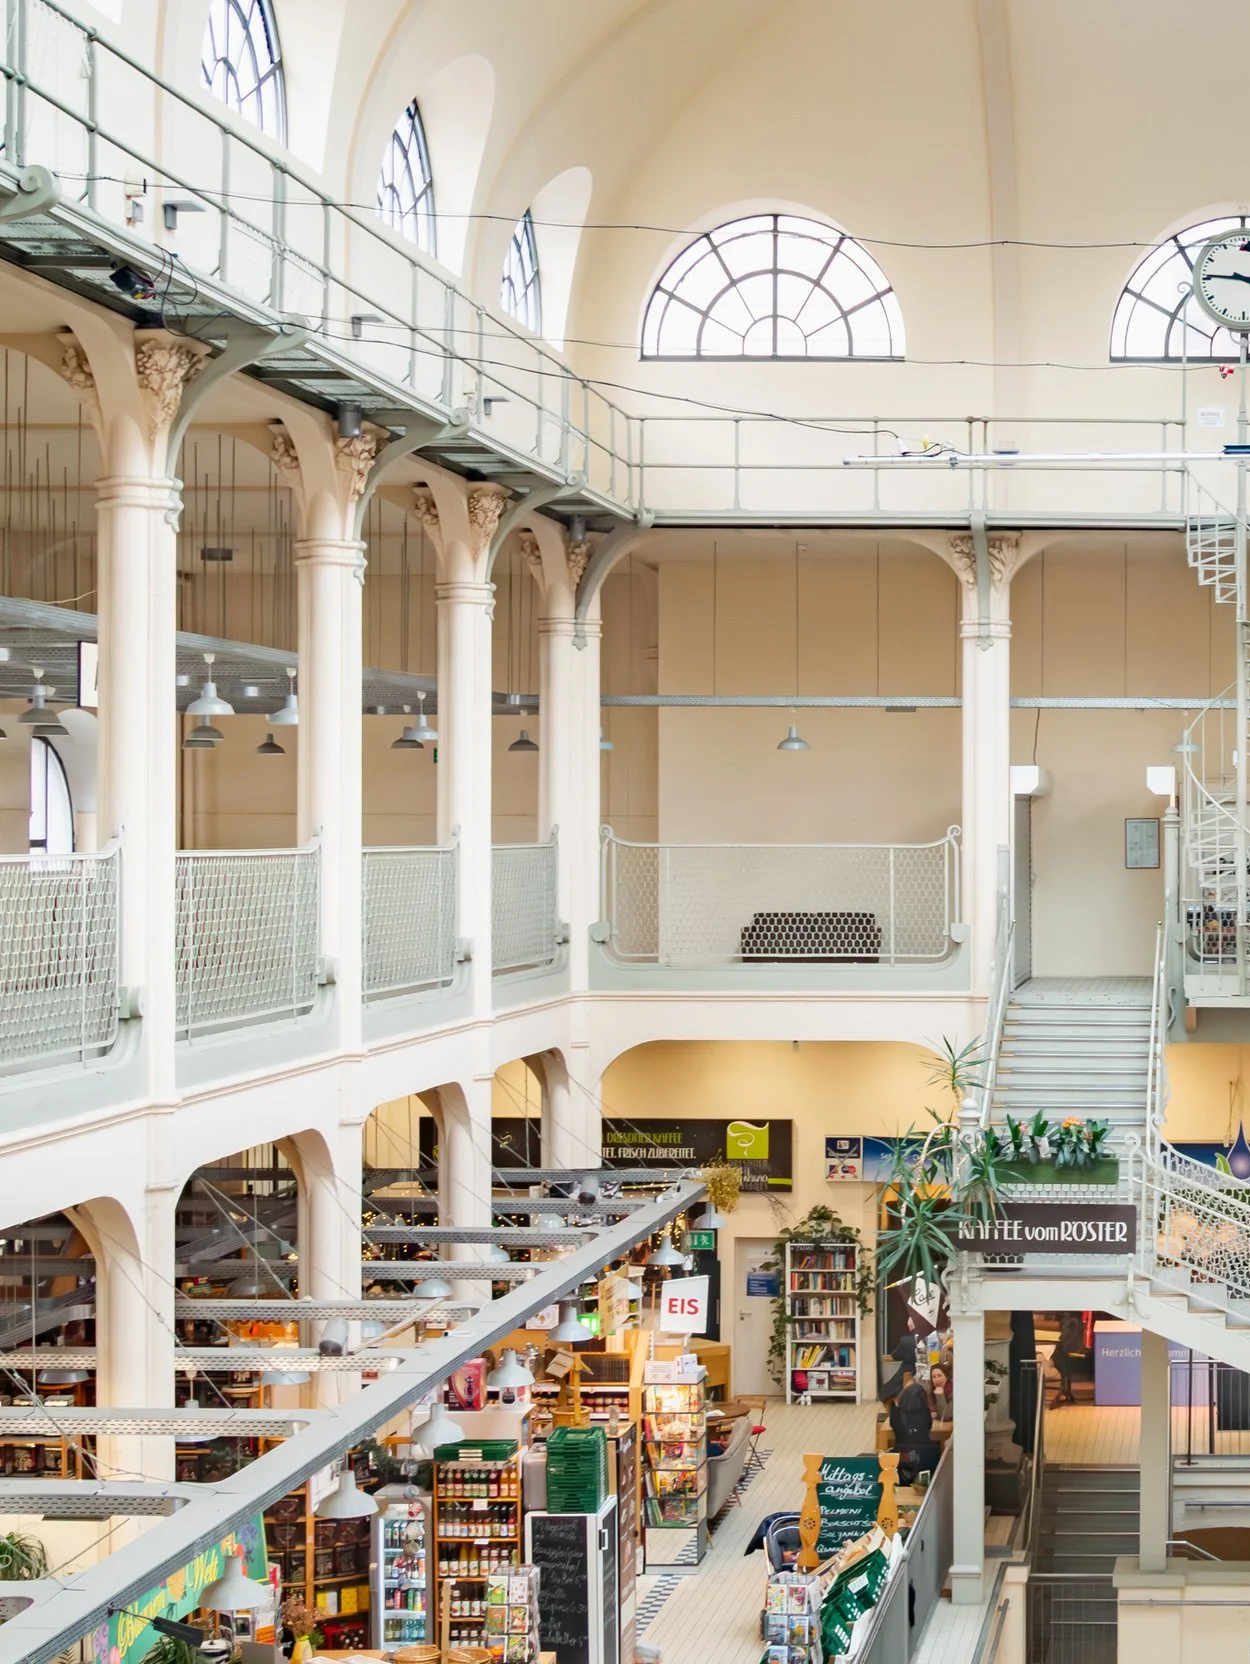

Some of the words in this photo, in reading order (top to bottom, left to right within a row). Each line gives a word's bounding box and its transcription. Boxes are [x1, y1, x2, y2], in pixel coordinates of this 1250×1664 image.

[652, 1131, 684, 1144] KAFFEE
[618, 1147, 646, 1159] FRISCH
[958, 1220, 1023, 1241] KAFFEE
[1024, 1226, 1058, 1241] vom
[1060, 1219, 1128, 1242] RÖSTER
[668, 1297, 699, 1315] EIS
[1101, 1347, 1142, 1358] Herzlich
